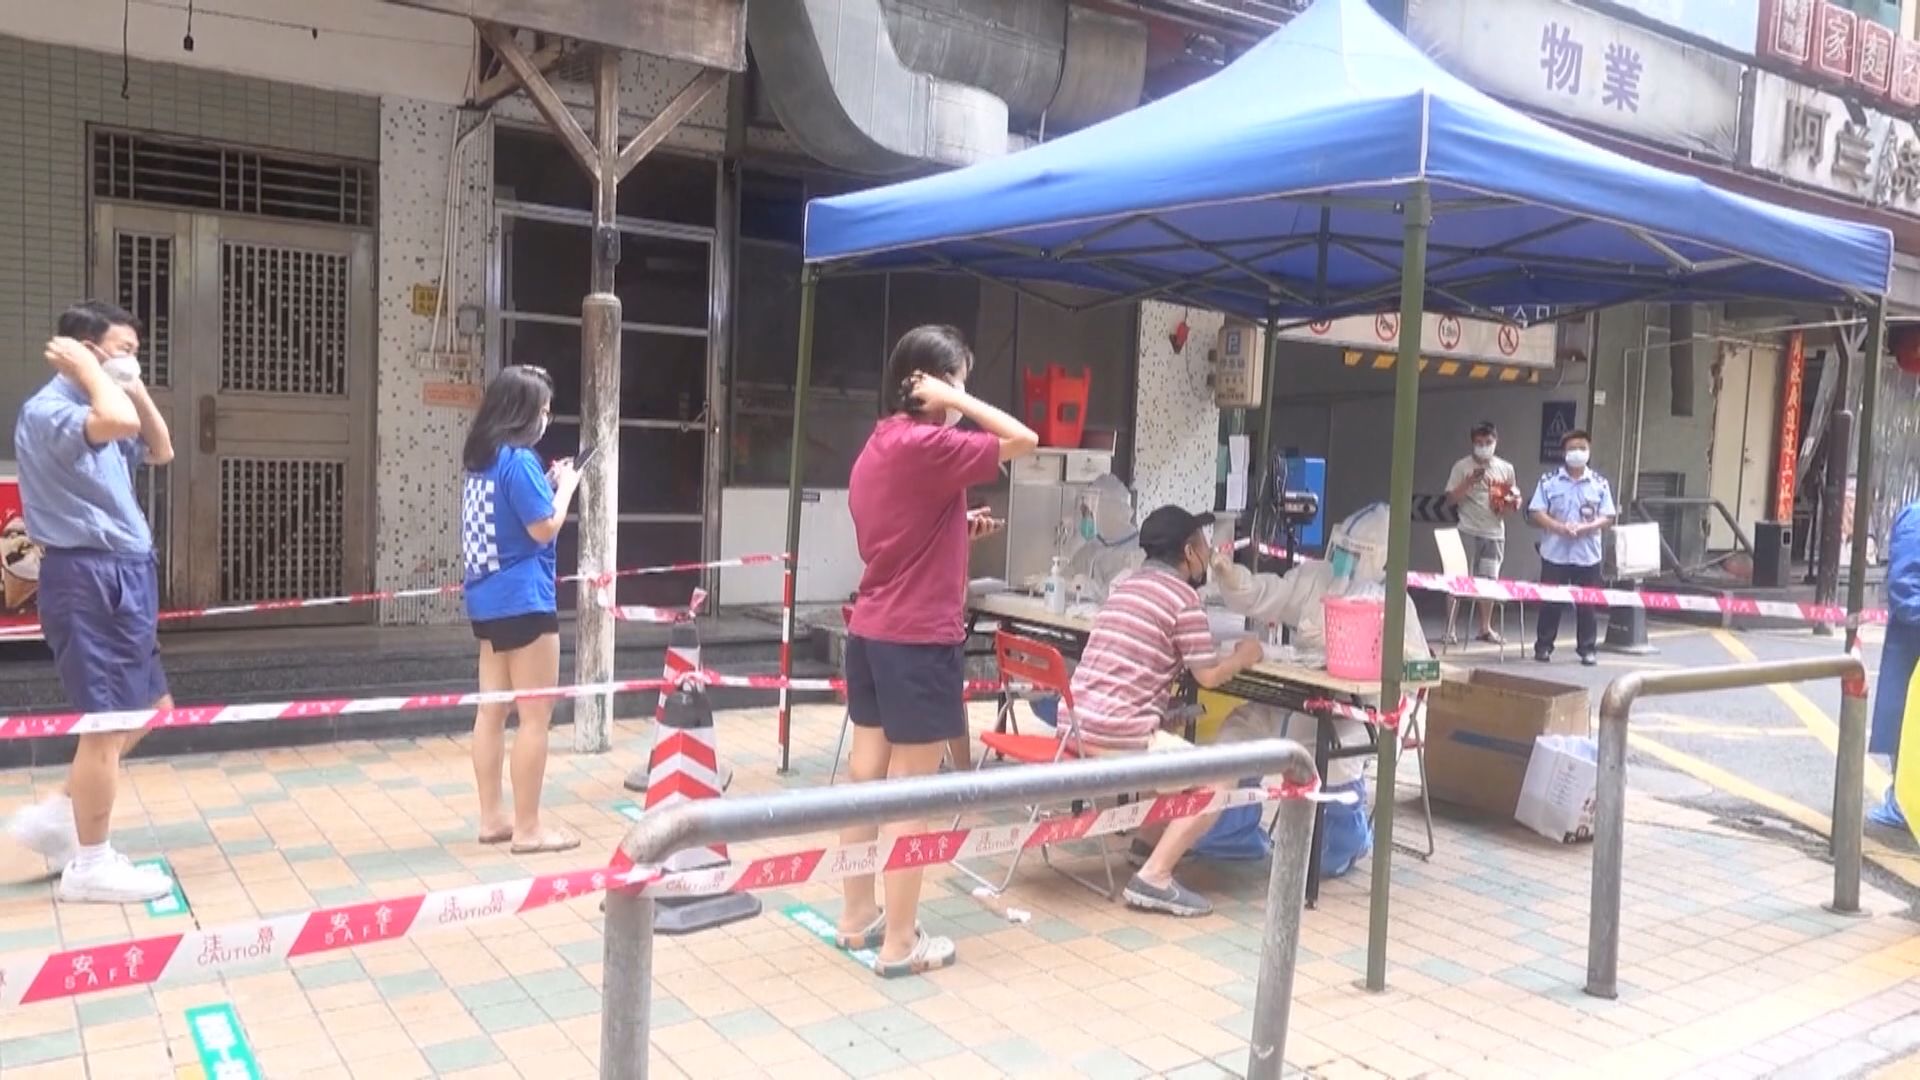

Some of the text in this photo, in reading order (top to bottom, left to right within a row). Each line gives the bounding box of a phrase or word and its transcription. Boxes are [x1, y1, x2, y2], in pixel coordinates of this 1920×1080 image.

[1541, 21, 1642, 113] 物業
[330, 904, 393, 931] 安全
[438, 905, 503, 924] CAUTION
[203, 926, 275, 954] 注意
[324, 921, 389, 944] SAFE
[71, 945, 145, 977] 安全
[197, 944, 272, 967] CAUTION
[65, 966, 138, 990] SAFE
